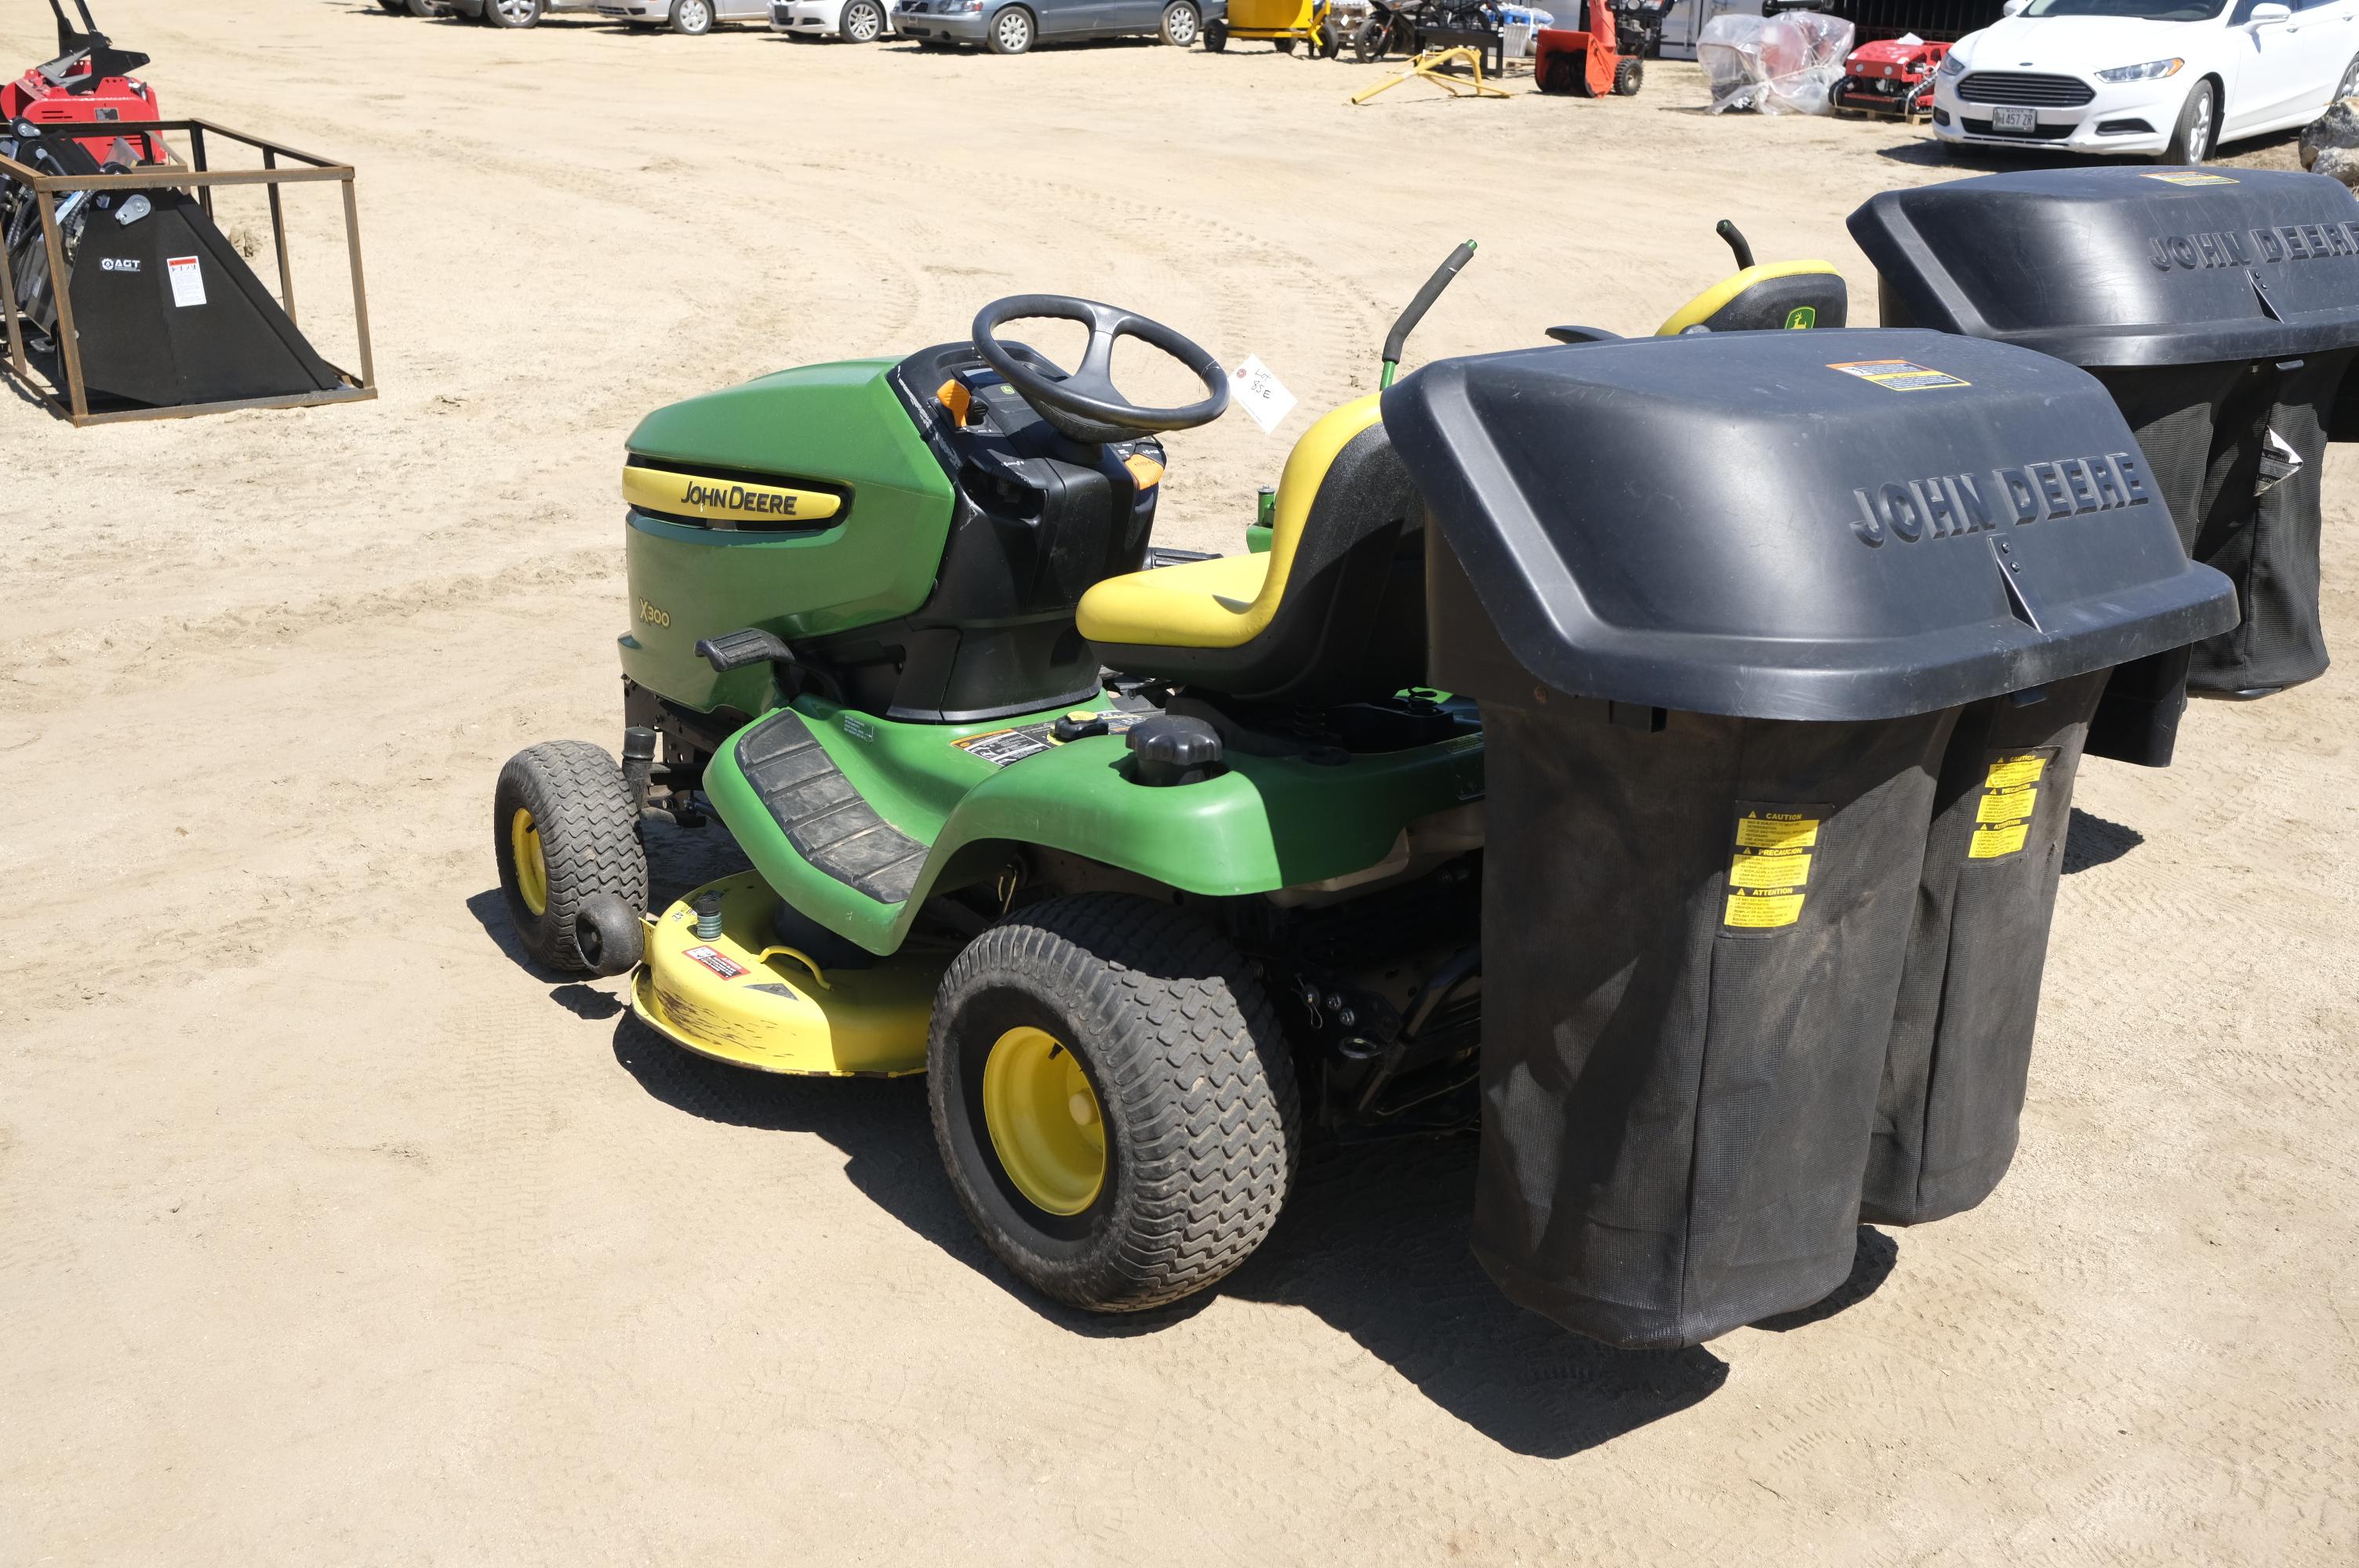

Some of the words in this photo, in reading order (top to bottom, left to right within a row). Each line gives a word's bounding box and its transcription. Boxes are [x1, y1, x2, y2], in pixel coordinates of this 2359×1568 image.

[114, 260, 140, 268] AGT
[2147, 230, 2252, 272] JOHN
[681, 481, 726, 509] JOHN
[729, 486, 798, 516] DEERE
[1849, 473, 1996, 549] JOHN
[1992, 452, 2149, 526] DEERE
[639, 597, 671, 630] X300
[1765, 812, 1803, 821] CAUTION
[1752, 887, 1794, 896] ATTENTION
